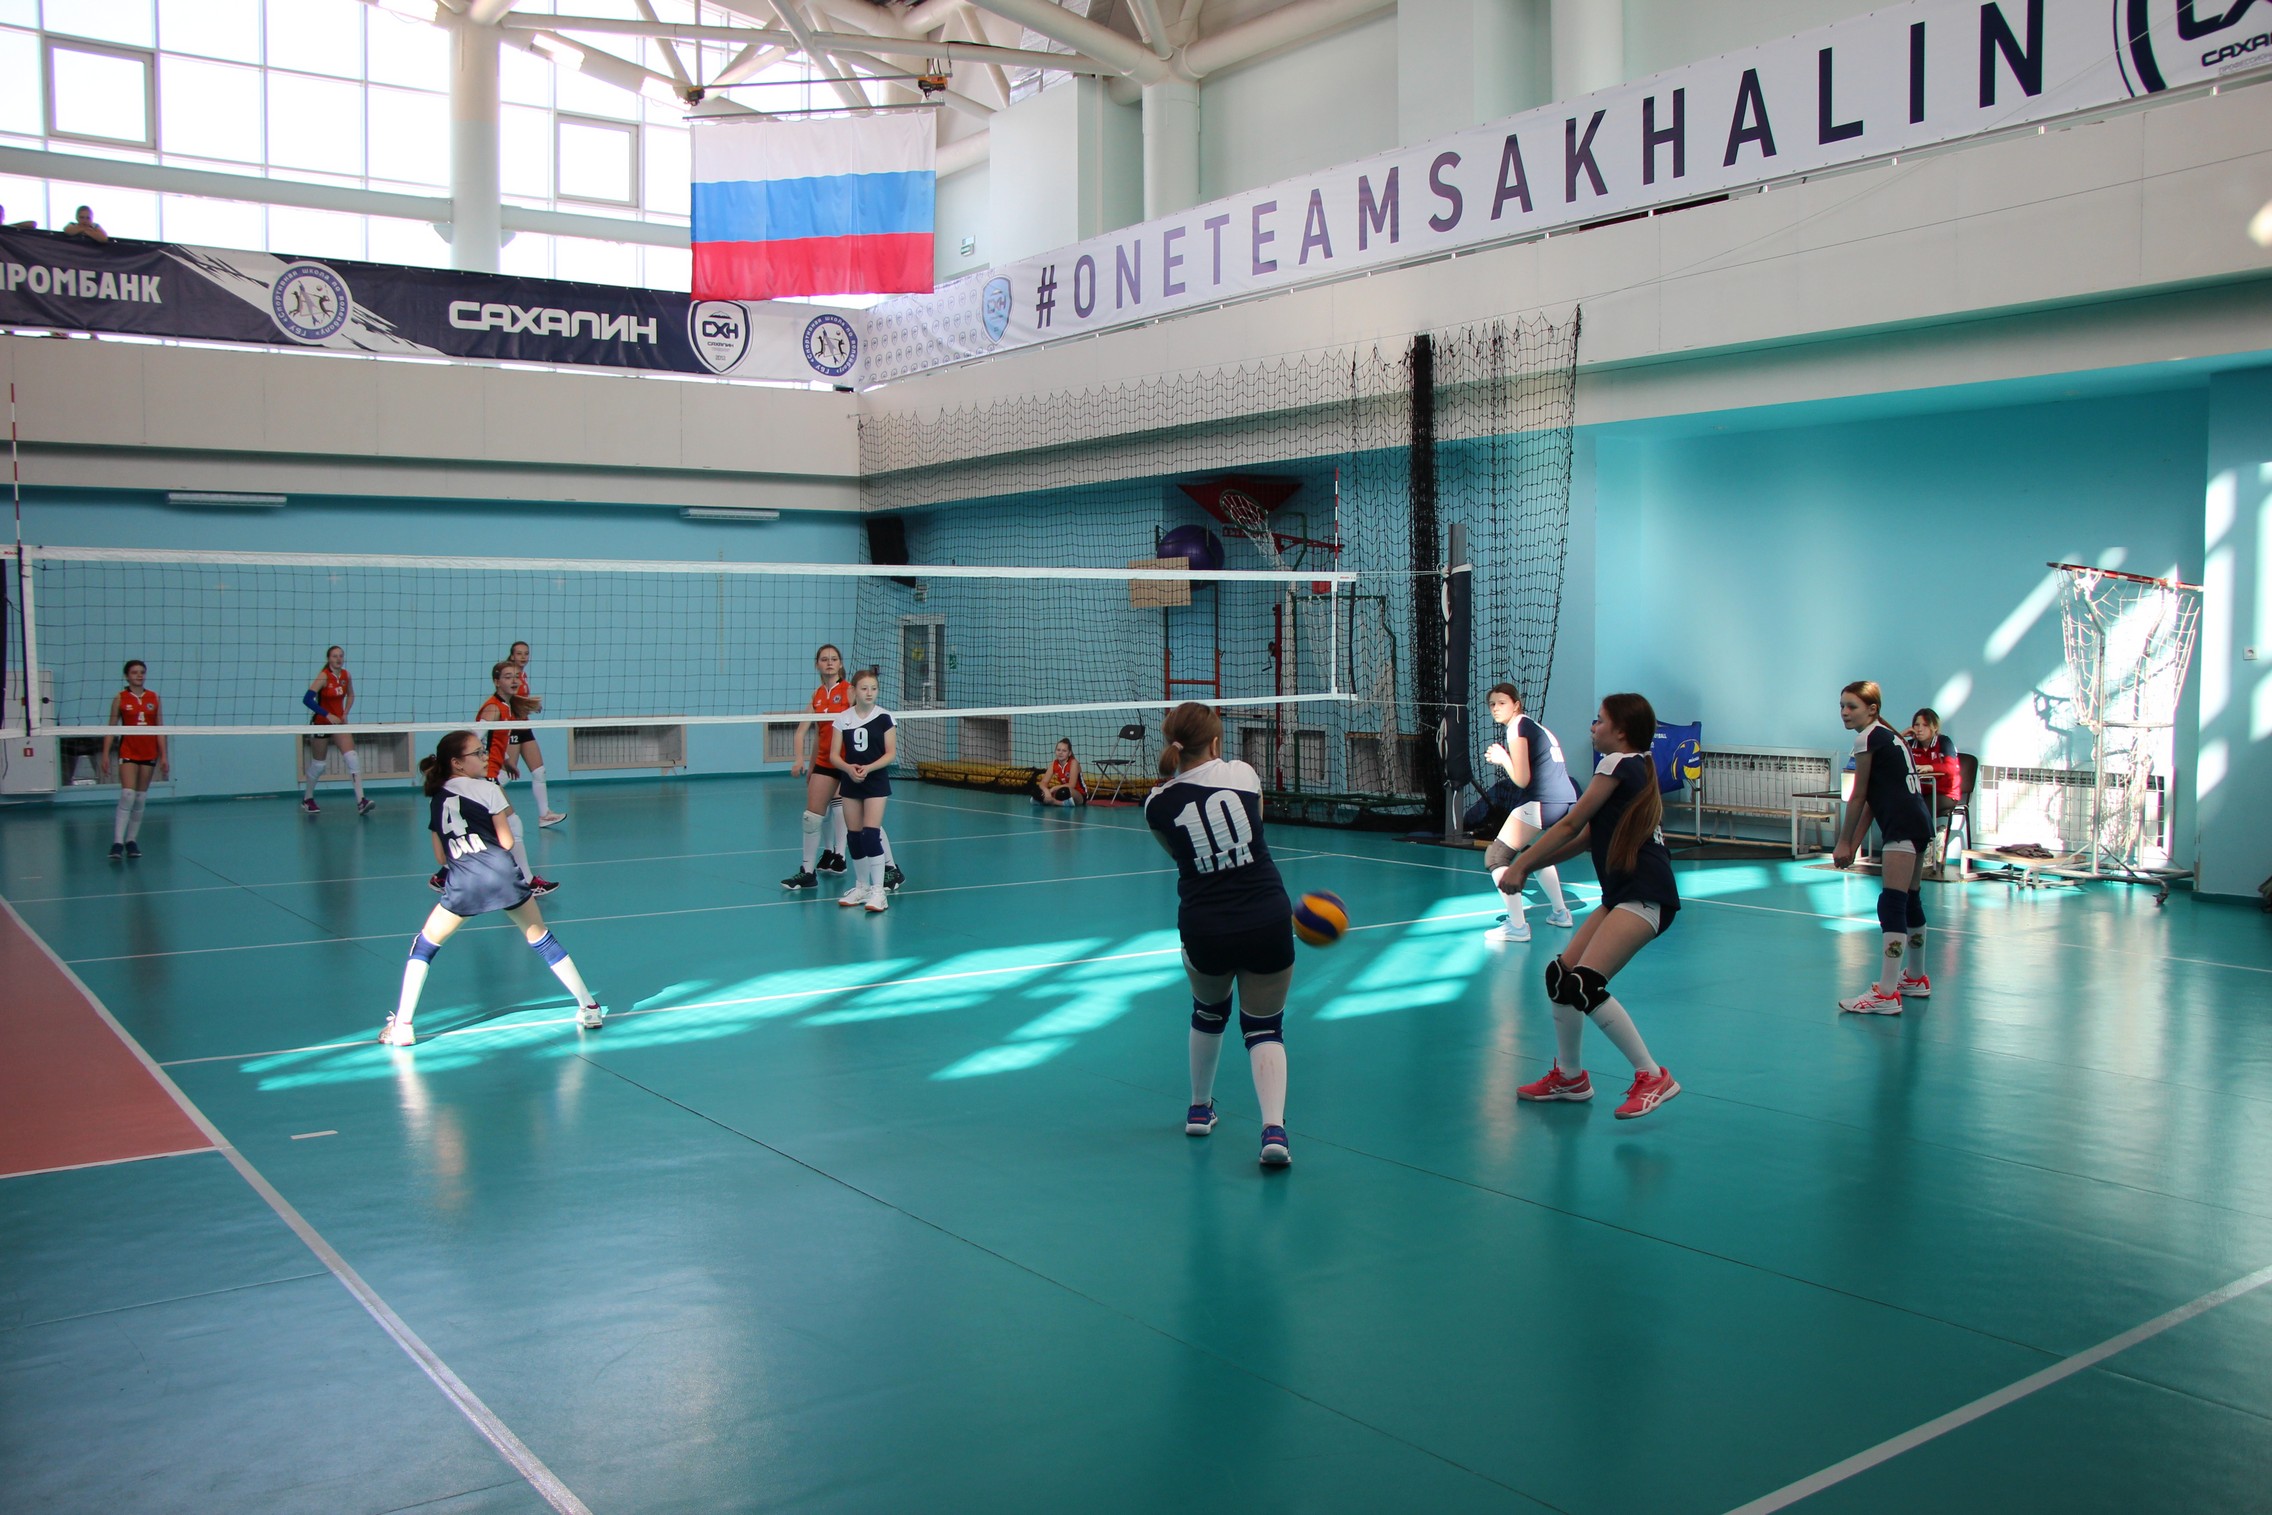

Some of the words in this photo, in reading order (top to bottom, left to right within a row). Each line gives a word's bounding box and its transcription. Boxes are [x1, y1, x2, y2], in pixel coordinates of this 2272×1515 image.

[2202, 33, 2272, 67] САХА
[0, 262, 162, 303] РОМБАНК
[449, 301, 657, 344] САХАЛИН
[510, 735, 519, 743] 12
[853, 727, 868, 752] 9
[441, 795, 468, 837] 4
[1173, 789, 1253, 858] 10
